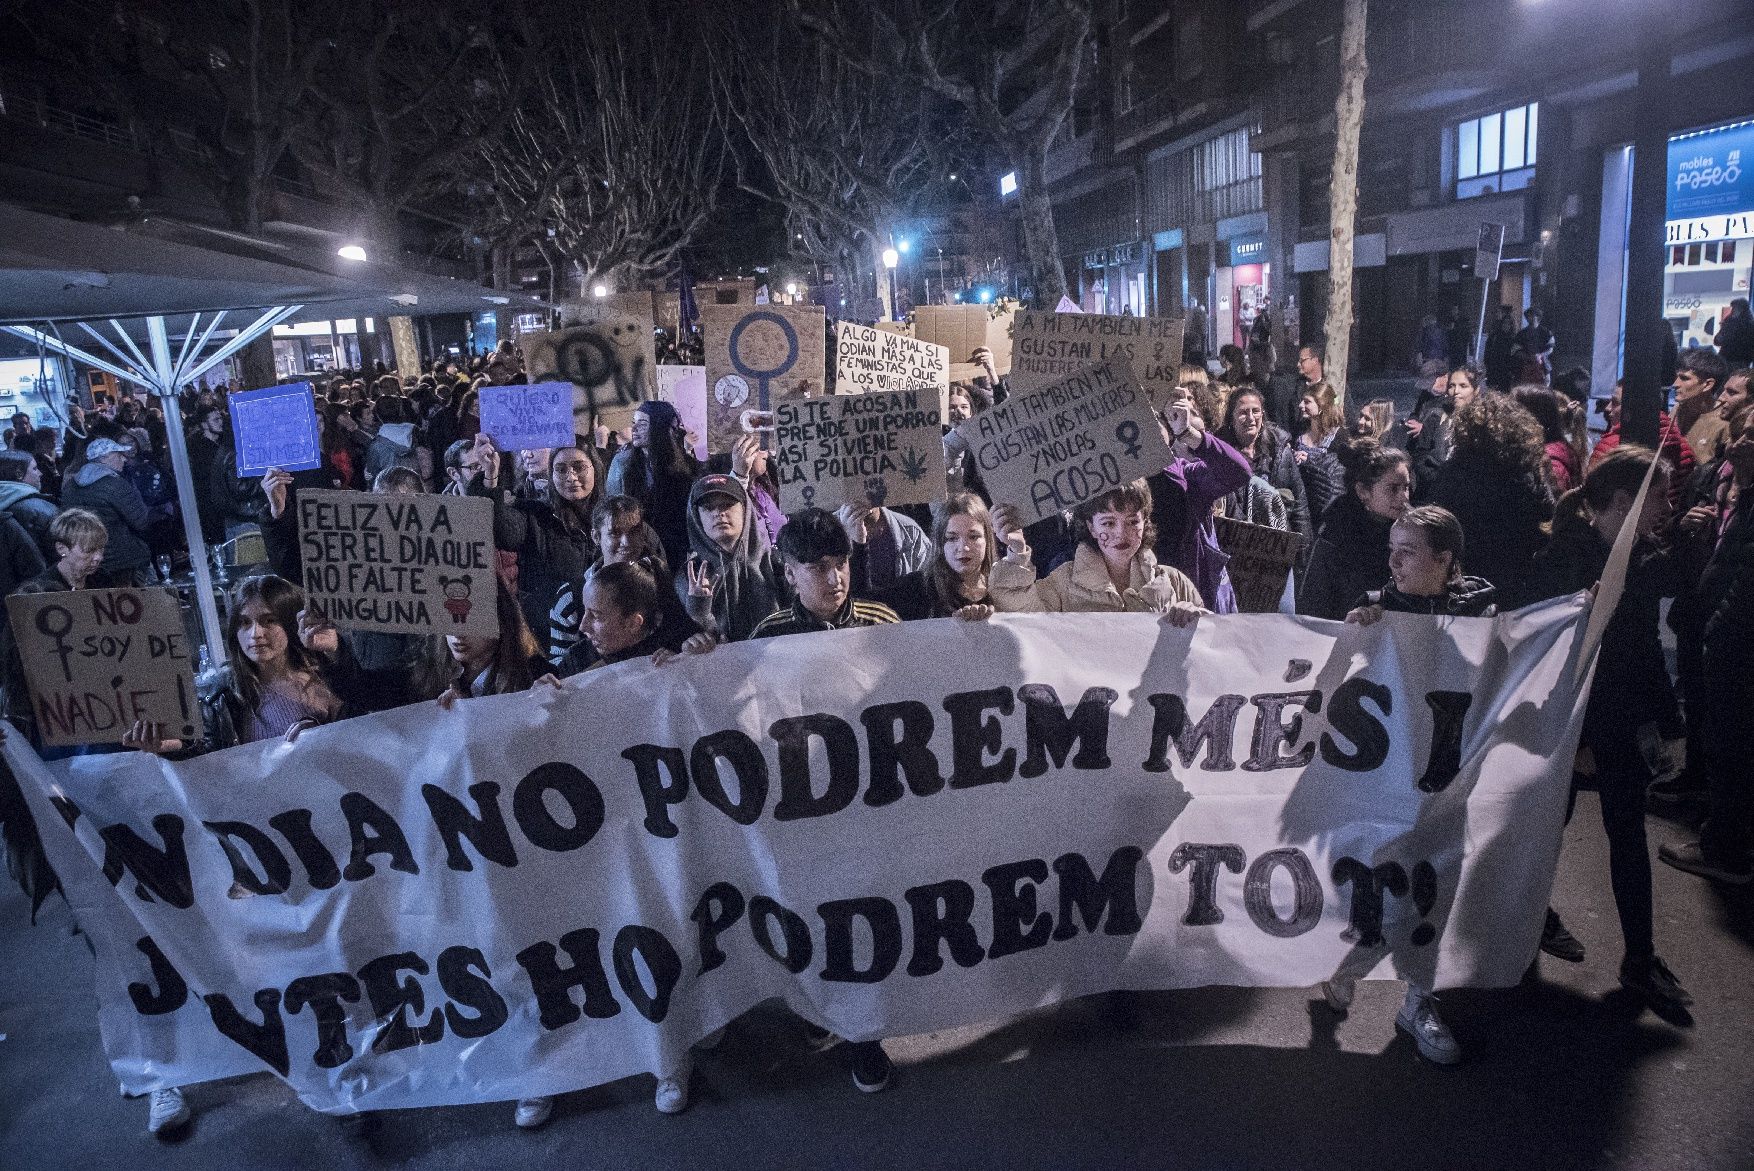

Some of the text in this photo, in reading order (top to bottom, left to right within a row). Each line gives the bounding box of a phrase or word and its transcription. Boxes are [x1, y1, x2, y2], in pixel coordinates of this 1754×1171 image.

[1680, 156, 1713, 171] mobles
[1022, 315, 1034, 330] A
[1149, 319, 1174, 337] ME
[840, 342, 875, 358] ODIAN
[908, 353, 916, 366] A
[920, 356, 943, 371] LAS
[842, 325, 938, 358] ALGO VA MAL SI
[1020, 337, 1135, 361] GUSTAN LAS
[838, 368, 847, 380] A
[851, 371, 874, 384] LOS
[839, 355, 937, 383] FEMINISTAS QUE
[1145, 365, 1174, 382] LAS
[777, 390, 918, 428] SI TE ACOSAN
[980, 416, 996, 438] A
[993, 404, 1018, 433] MI
[1092, 363, 1118, 391] ME
[776, 410, 940, 446] PRENDE UN PORRO
[978, 382, 1136, 470] GUSTAN LAS MUJERES
[246, 447, 272, 464] SIN
[843, 432, 898, 455] VIENE
[780, 464, 807, 484] LA
[1030, 452, 1122, 518] ACOSO
[300, 499, 452, 534] FELIZ VA A
[303, 531, 487, 569] SER EL DIA QUE
[306, 563, 427, 594] NO FALTE
[92, 591, 144, 625] NO
[309, 598, 432, 626] NINGUNA
[79, 633, 187, 663] SOY DE
[49, 659, 1473, 909] N DIA NO PODREM MÉS I
[516, 925, 682, 1030] HO
[690, 846, 1143, 984] PODREM
[1167, 842, 1438, 947] TOT!
